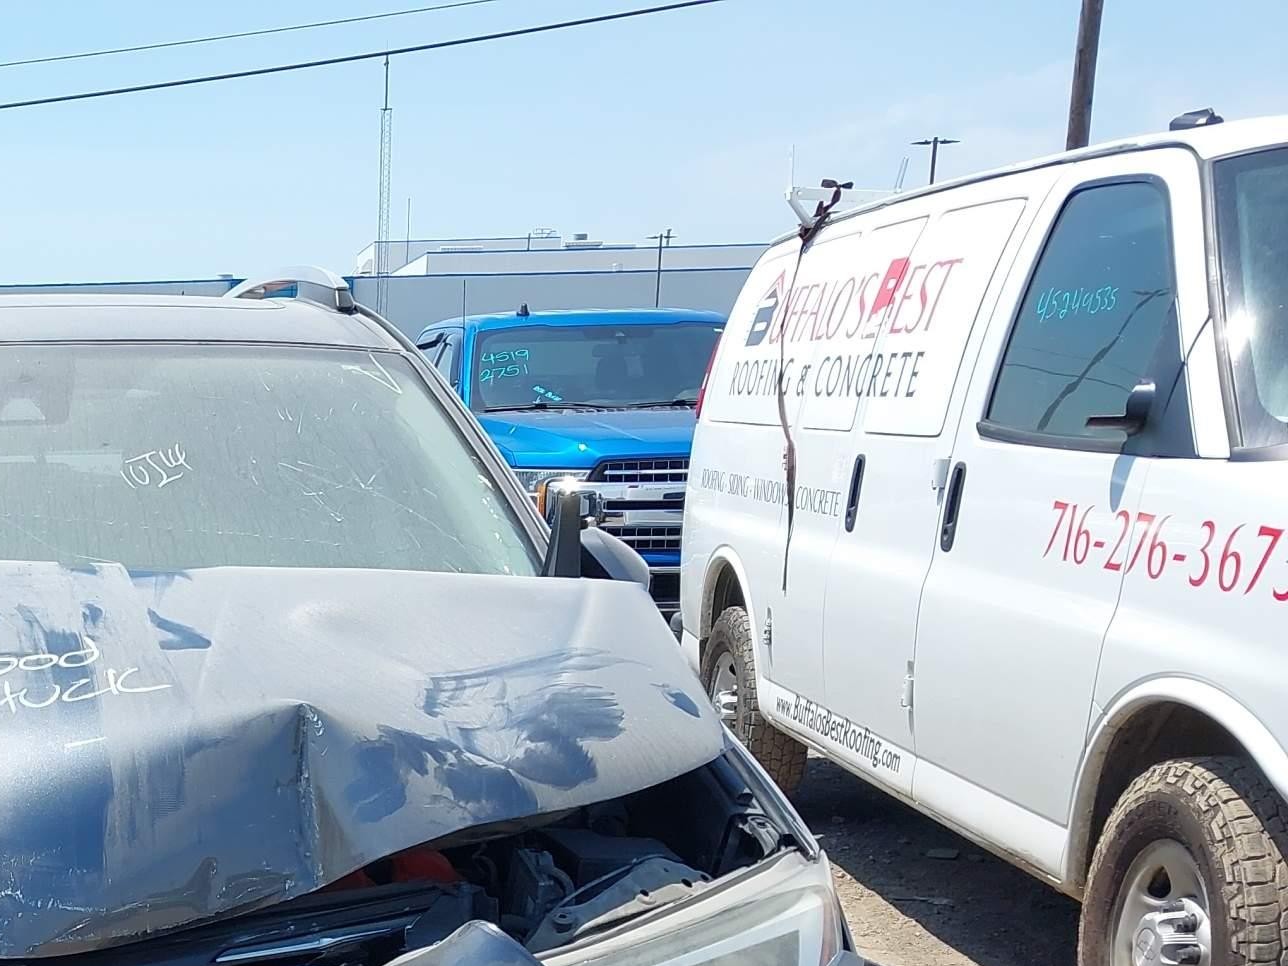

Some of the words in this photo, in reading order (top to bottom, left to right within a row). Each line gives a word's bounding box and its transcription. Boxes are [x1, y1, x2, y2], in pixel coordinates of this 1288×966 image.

[481, 349, 530, 363] 4519
[480, 364, 529, 384] 2751
[729, 357, 795, 397] ROOFING
[796, 364, 812, 398] &
[814, 351, 925, 398] CONCRETE
[795, 485, 842, 517] CONCRETE
[776, 694, 901, 773] www.BuffalosBestRoofing.com
